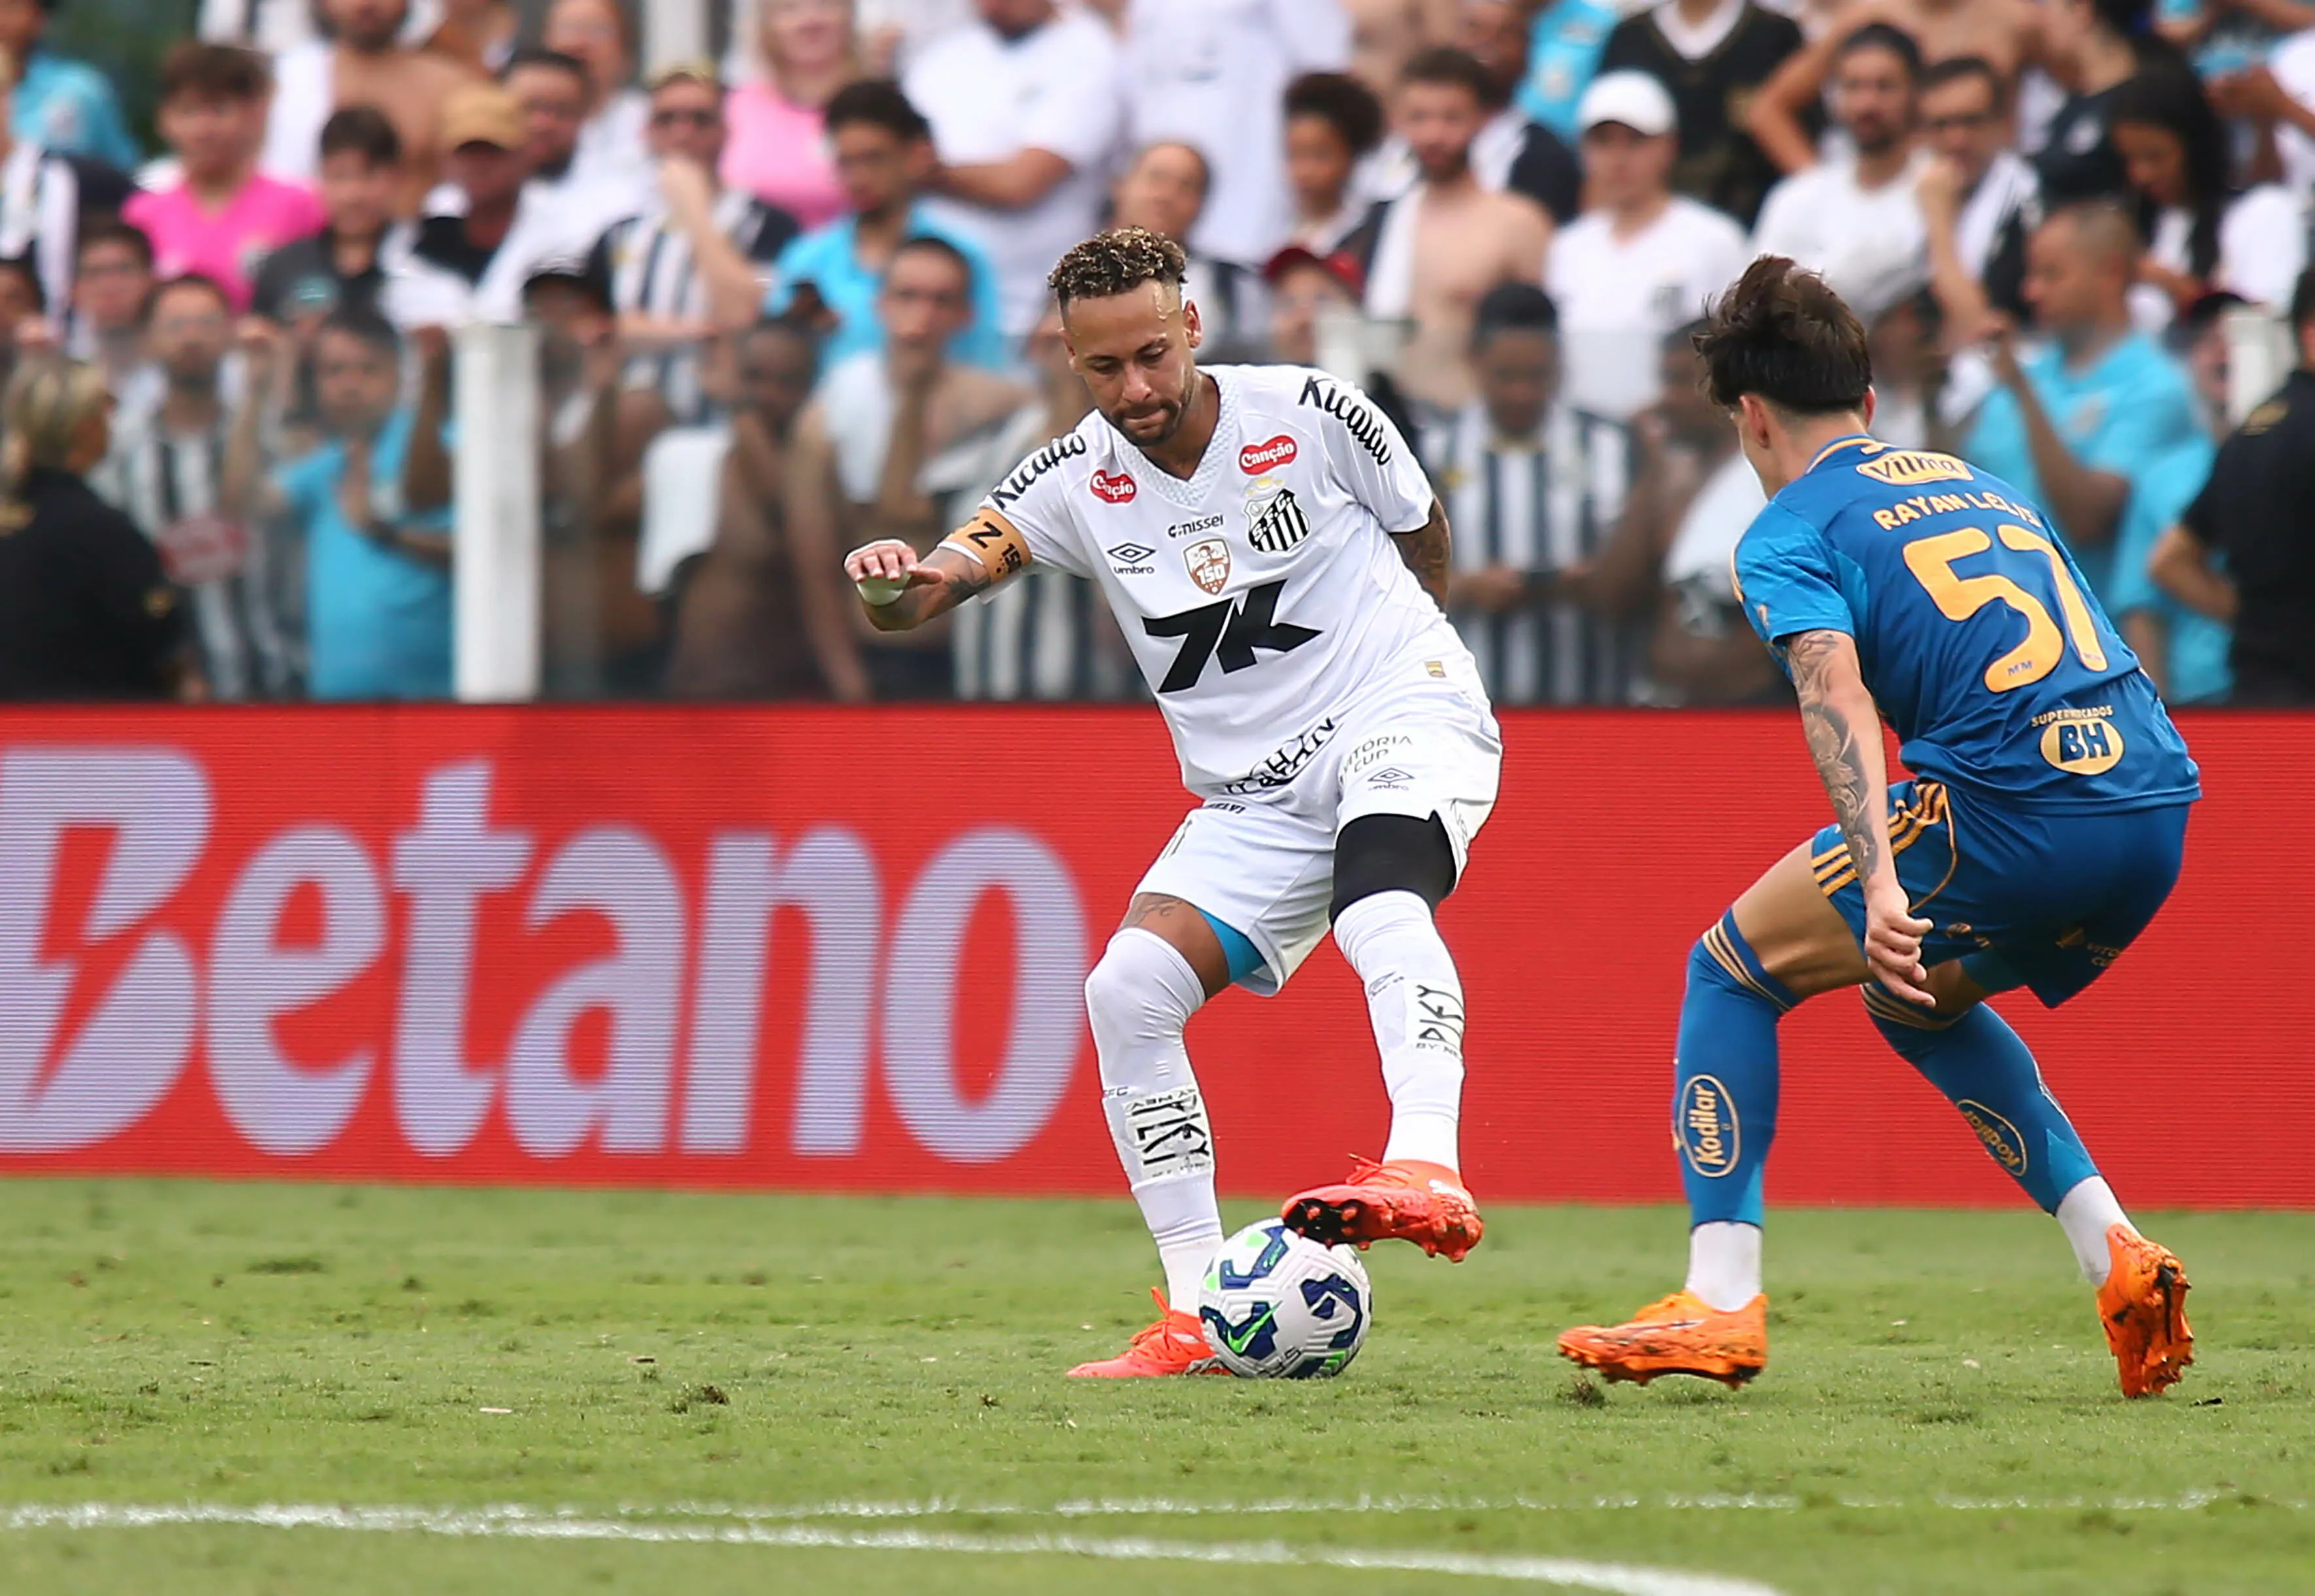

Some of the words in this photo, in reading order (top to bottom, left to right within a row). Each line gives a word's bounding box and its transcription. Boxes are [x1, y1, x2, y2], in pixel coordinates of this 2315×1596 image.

[1241, 442, 1295, 468] Canção
[1869, 455, 1958, 479] Vilma
[1871, 494, 1971, 530] RAYAN
[1113, 565, 1156, 575] umbro
[1196, 564, 1226, 585] 150
[1902, 524, 2108, 694] 57
[1141, 579, 1324, 694] 7K
[1354, 748, 1389, 773] CUP
[2058, 722, 2112, 763] BH
[0, 744, 1090, 1163] Betano
[1688, 1083, 1728, 1165] Kodilar
